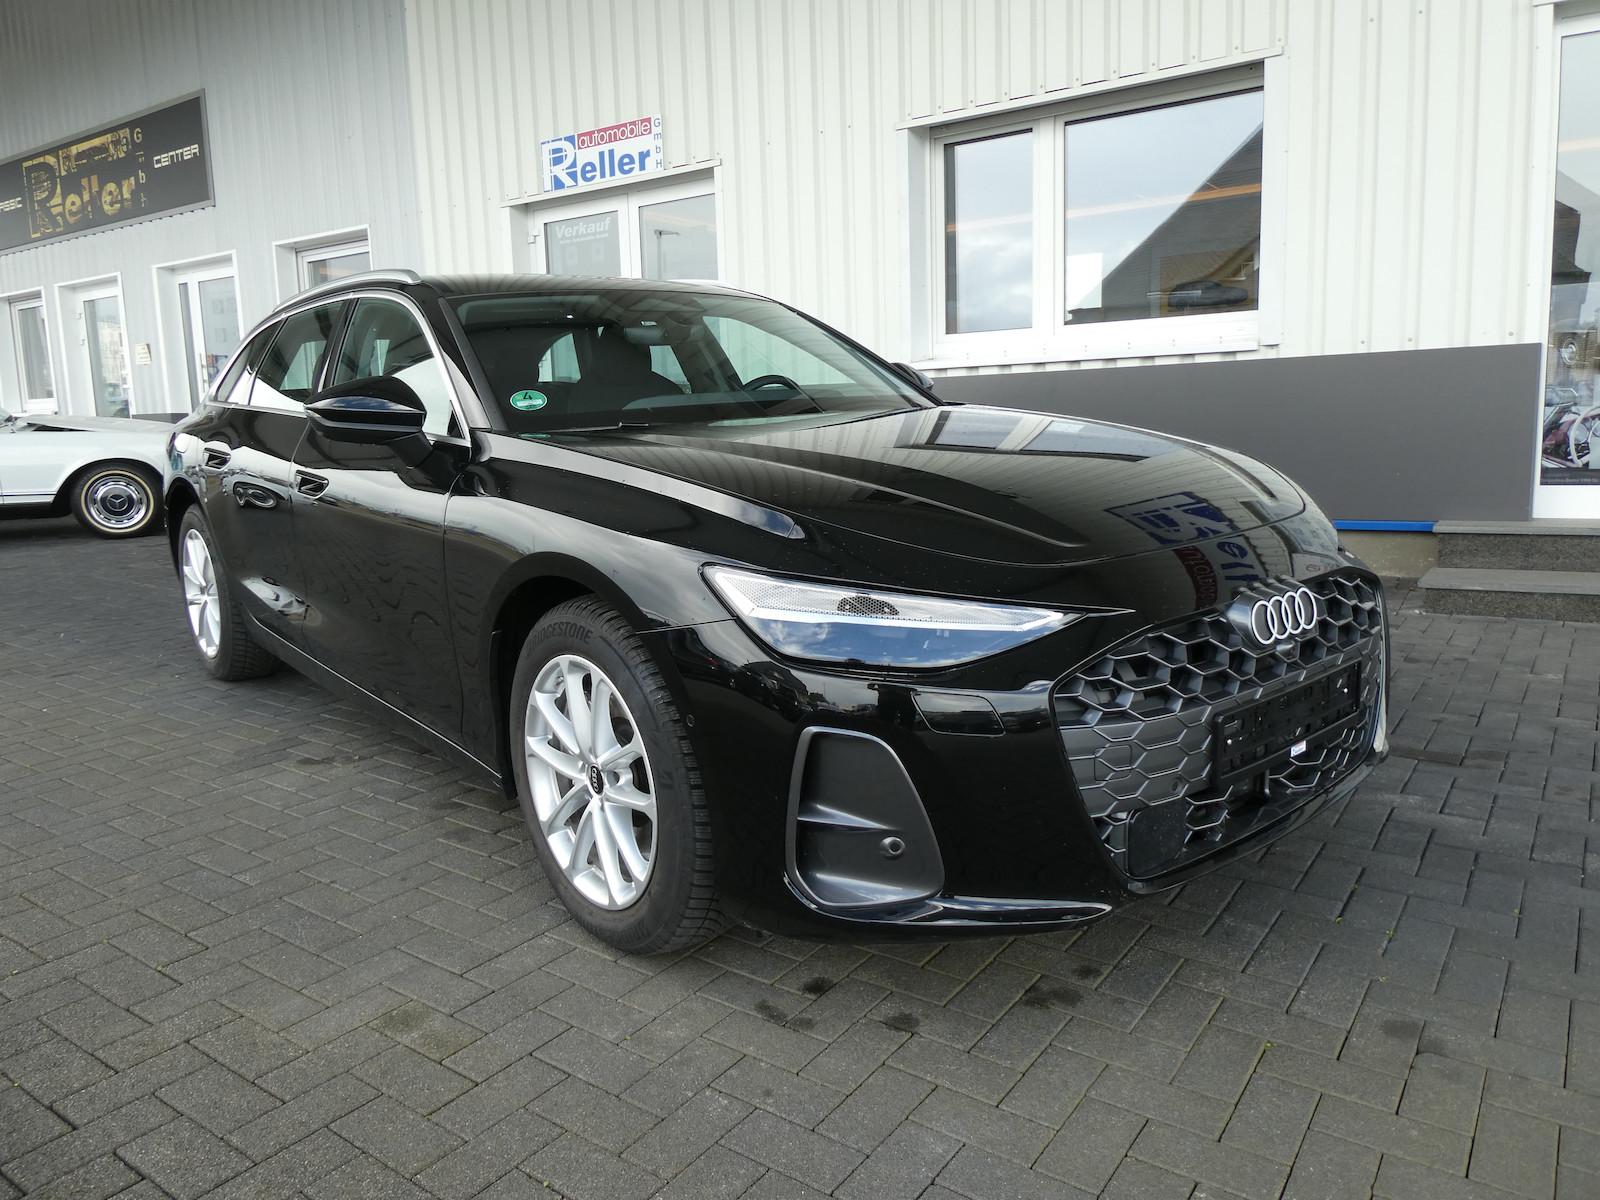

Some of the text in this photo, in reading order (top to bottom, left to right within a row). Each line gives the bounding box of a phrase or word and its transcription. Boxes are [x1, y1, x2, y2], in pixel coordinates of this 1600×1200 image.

[578, 121, 651, 148] automobile
[653, 118, 663, 168] GmbH
[153, 144, 199, 168] CENTER
[541, 139, 651, 192] Reller
[556, 217, 611, 239] Verkauf
